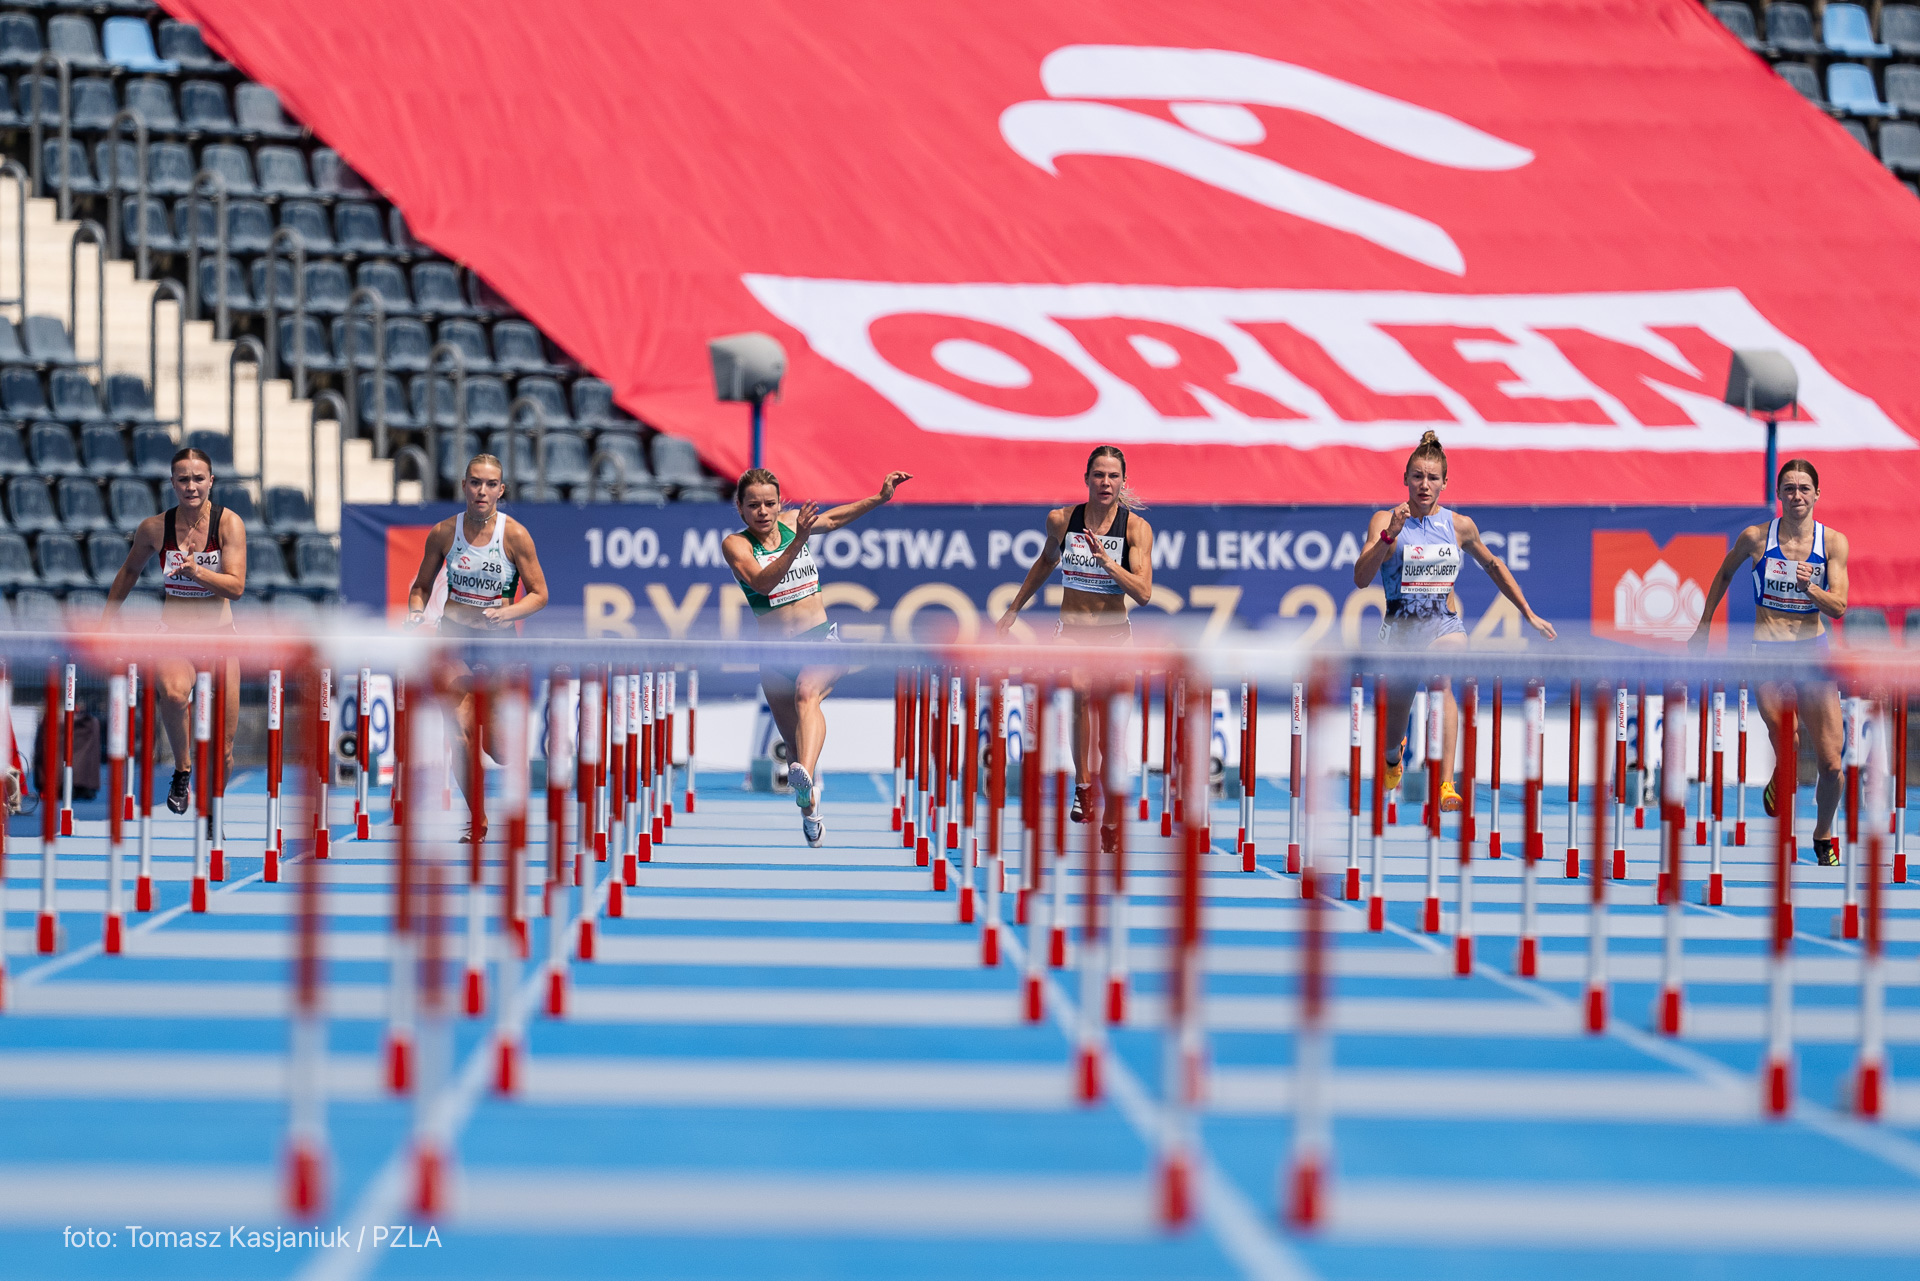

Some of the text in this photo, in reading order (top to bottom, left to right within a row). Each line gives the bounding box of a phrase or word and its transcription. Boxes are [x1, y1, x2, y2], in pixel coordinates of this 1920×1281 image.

[868, 311, 1819, 427] ORLEN
[585, 527, 669, 568] 100.
[680, 528, 977, 570] MZOSTWA
[1151, 530, 1187, 569] W
[1197, 530, 1530, 571] LEKKOACE
[1438, 548, 1452, 557] 64
[197, 555, 218, 566] 342
[482, 562, 502, 574] 258
[1404, 564, 1456, 576] SUŁEK-SCHUBERT
[453, 571, 502, 592] ŻUROWSKA
